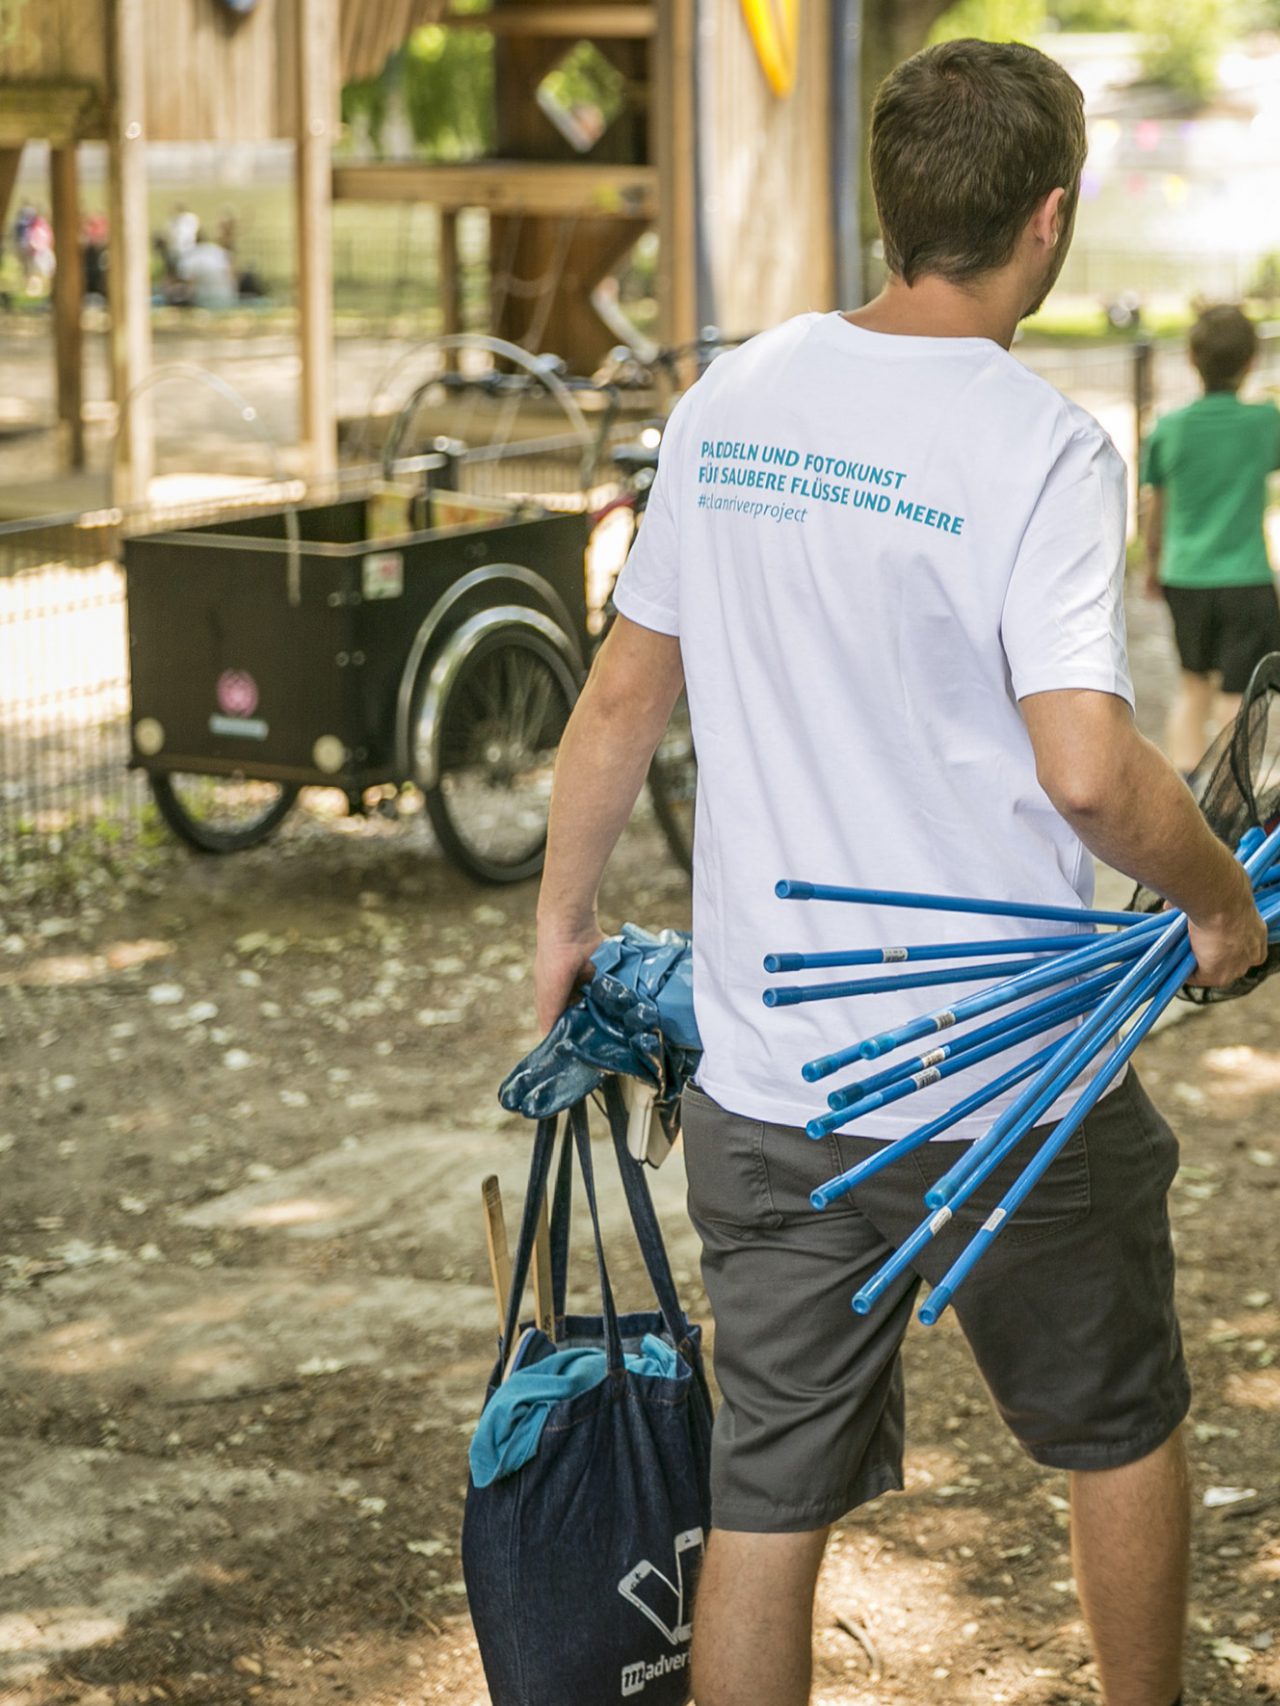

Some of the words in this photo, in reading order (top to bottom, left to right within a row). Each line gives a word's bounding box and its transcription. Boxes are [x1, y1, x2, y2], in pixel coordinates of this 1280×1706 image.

[701, 441, 759, 461] PADDELN
[762, 446, 800, 467] UND
[804, 453, 907, 490] FOTOKUNST
[697, 493, 808, 523] #clanriverproject
[720, 467, 787, 492] SAUBERE
[791, 476, 850, 505] FLÜSSE
[853, 489, 891, 513] UND
[895, 499, 965, 535] MEERE
